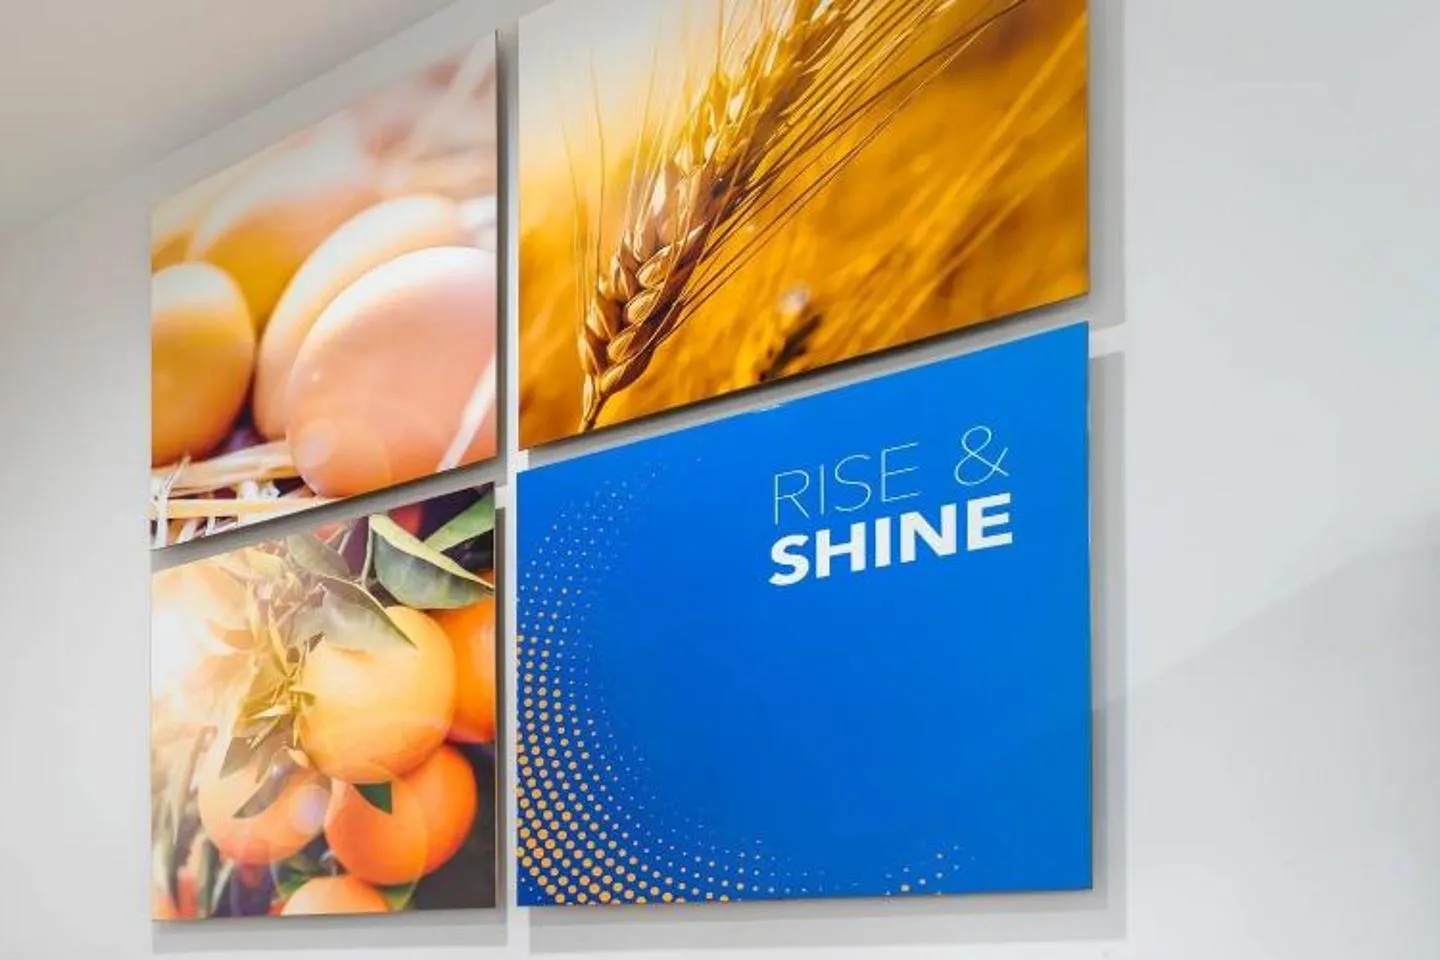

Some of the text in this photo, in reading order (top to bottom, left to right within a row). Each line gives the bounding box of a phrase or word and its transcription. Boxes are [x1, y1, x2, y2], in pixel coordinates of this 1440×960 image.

[774, 425, 1010, 525] RISE &
[768, 493, 1013, 586] SHINE
